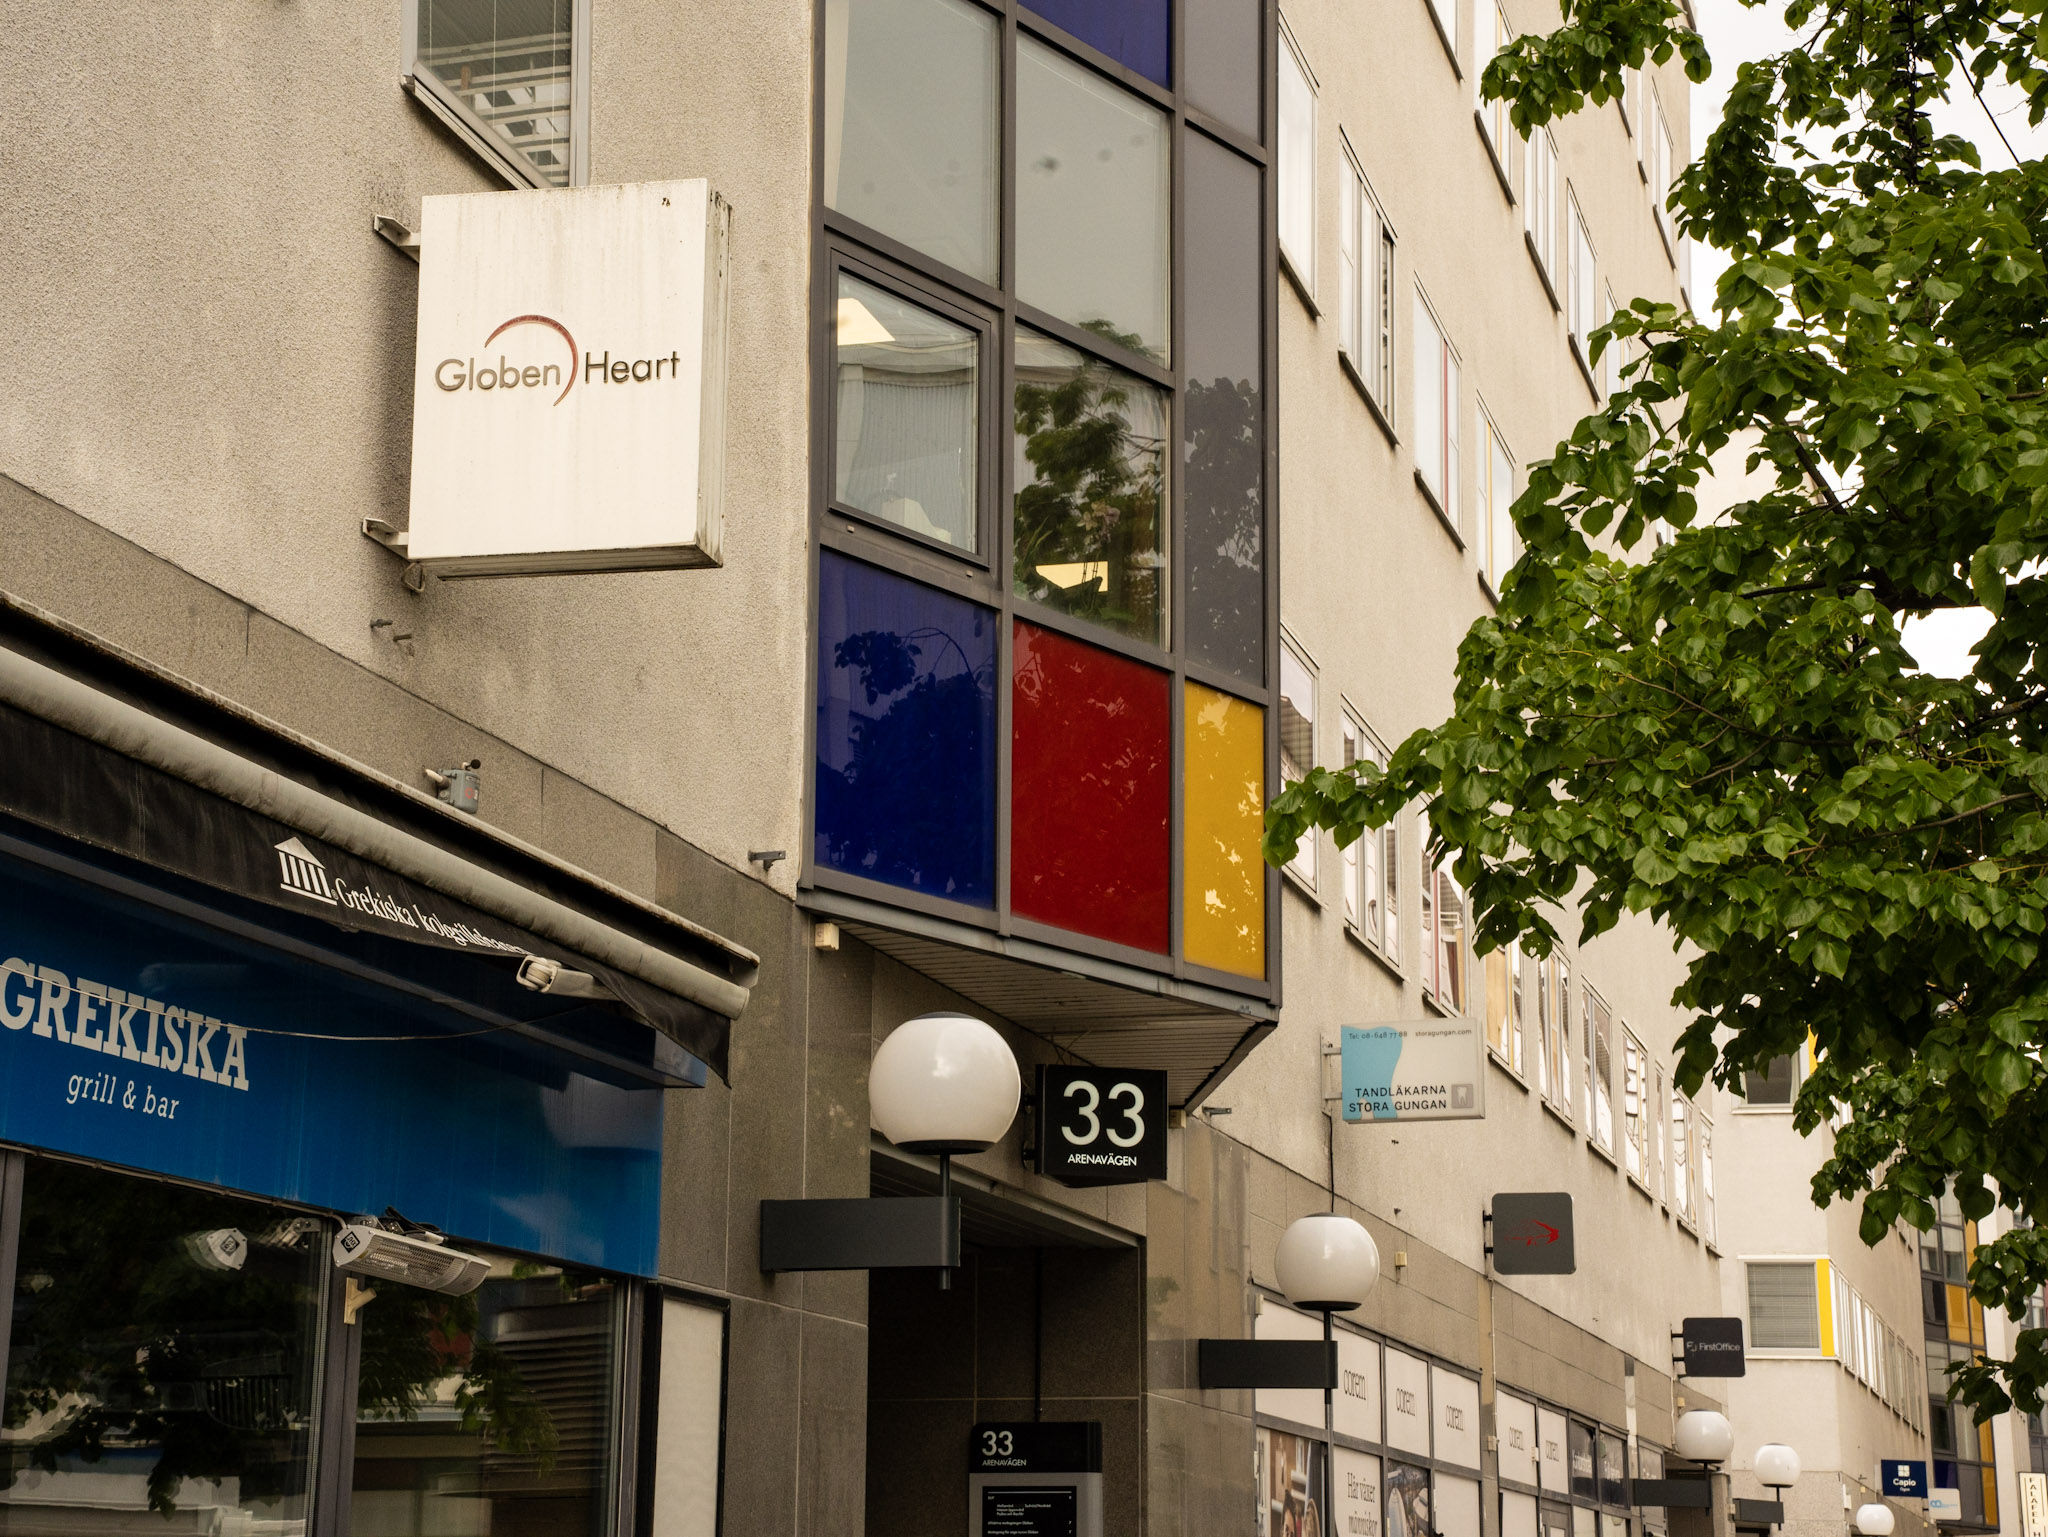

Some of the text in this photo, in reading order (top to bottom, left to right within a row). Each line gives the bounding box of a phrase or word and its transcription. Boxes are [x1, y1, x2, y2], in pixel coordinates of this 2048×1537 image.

[435, 351, 680, 392] Globen Heart
[334, 877, 419, 929] Grekiska
[0, 957, 249, 1092] GREKISKA
[1415, 1029, 1472, 1037] storagungan.com
[66, 1072, 180, 1120] grill & bar
[1355, 1085, 1446, 1098] TANDLÄKARNA
[1061, 1080, 1145, 1148] 33
[1348, 1099, 1447, 1113] STORA GUNGAN
[1067, 1152, 1137, 1166] ARENAVÄGEN
[1699, 1342, 1740, 1351] FirstOffice
[981, 1430, 1014, 1457] 33
[981, 1458, 1027, 1467] ARENAVÄGEN
[1892, 1478, 1917, 1487] Capio
[2029, 1477, 2039, 1525] FALAFEL
